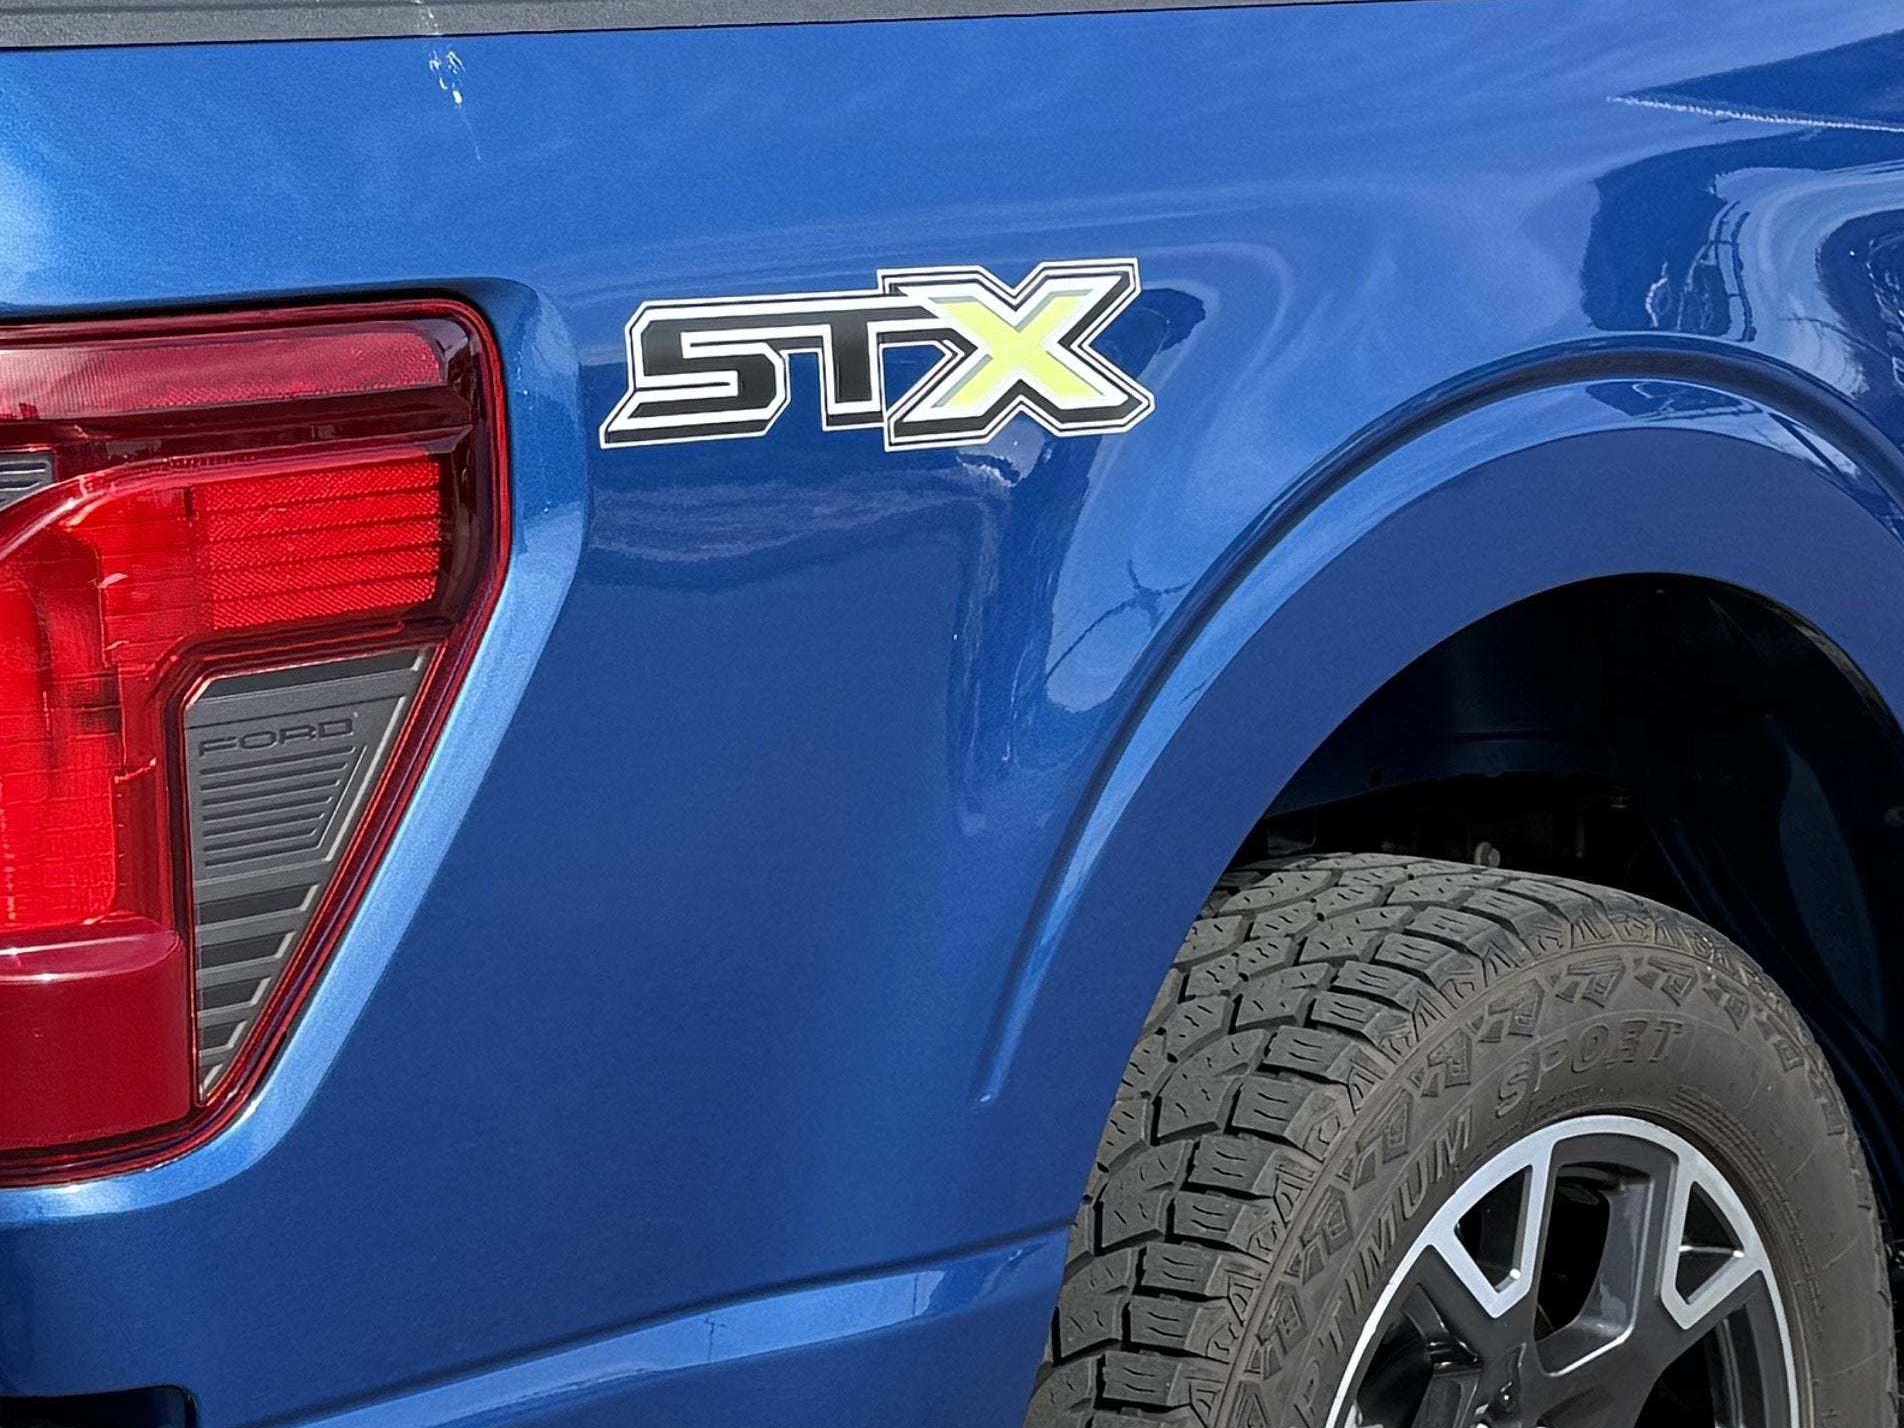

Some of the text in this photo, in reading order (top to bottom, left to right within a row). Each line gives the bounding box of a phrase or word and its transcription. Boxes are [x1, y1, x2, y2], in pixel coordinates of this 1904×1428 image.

[600, 257, 1155, 452] STX
[199, 718, 353, 758] FORD
[1496, 1018, 1683, 1119] SPORT
